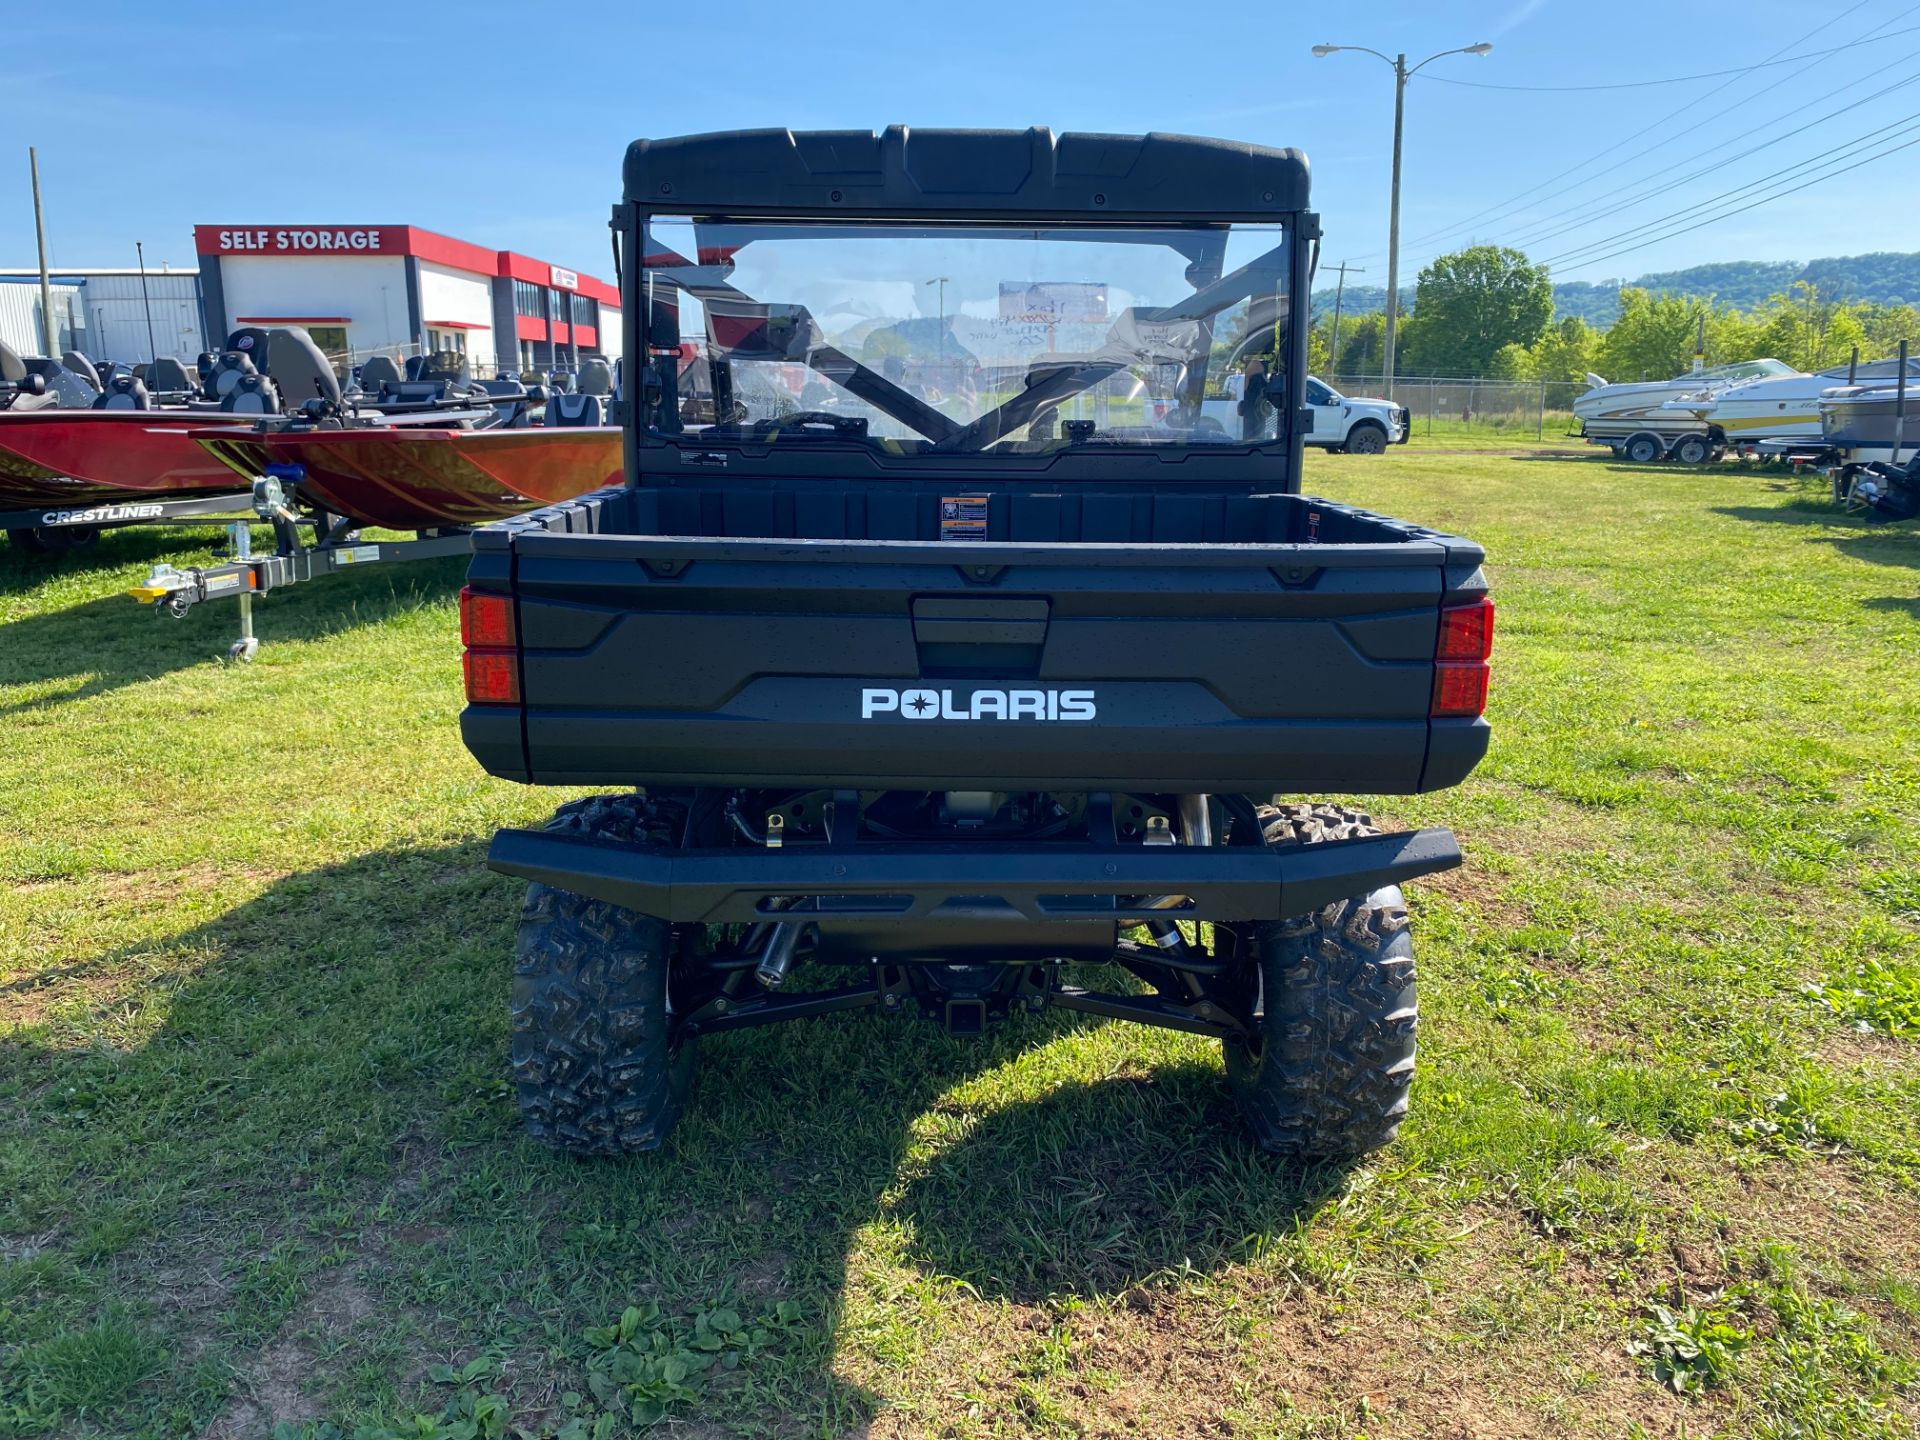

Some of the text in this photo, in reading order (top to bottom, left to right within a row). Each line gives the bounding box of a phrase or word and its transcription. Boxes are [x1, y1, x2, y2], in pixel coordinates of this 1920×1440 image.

[219, 231, 380, 249] SELF STORAGE
[42, 505, 163, 524] CRESTLINER
[862, 689, 1096, 720] POLARIS
